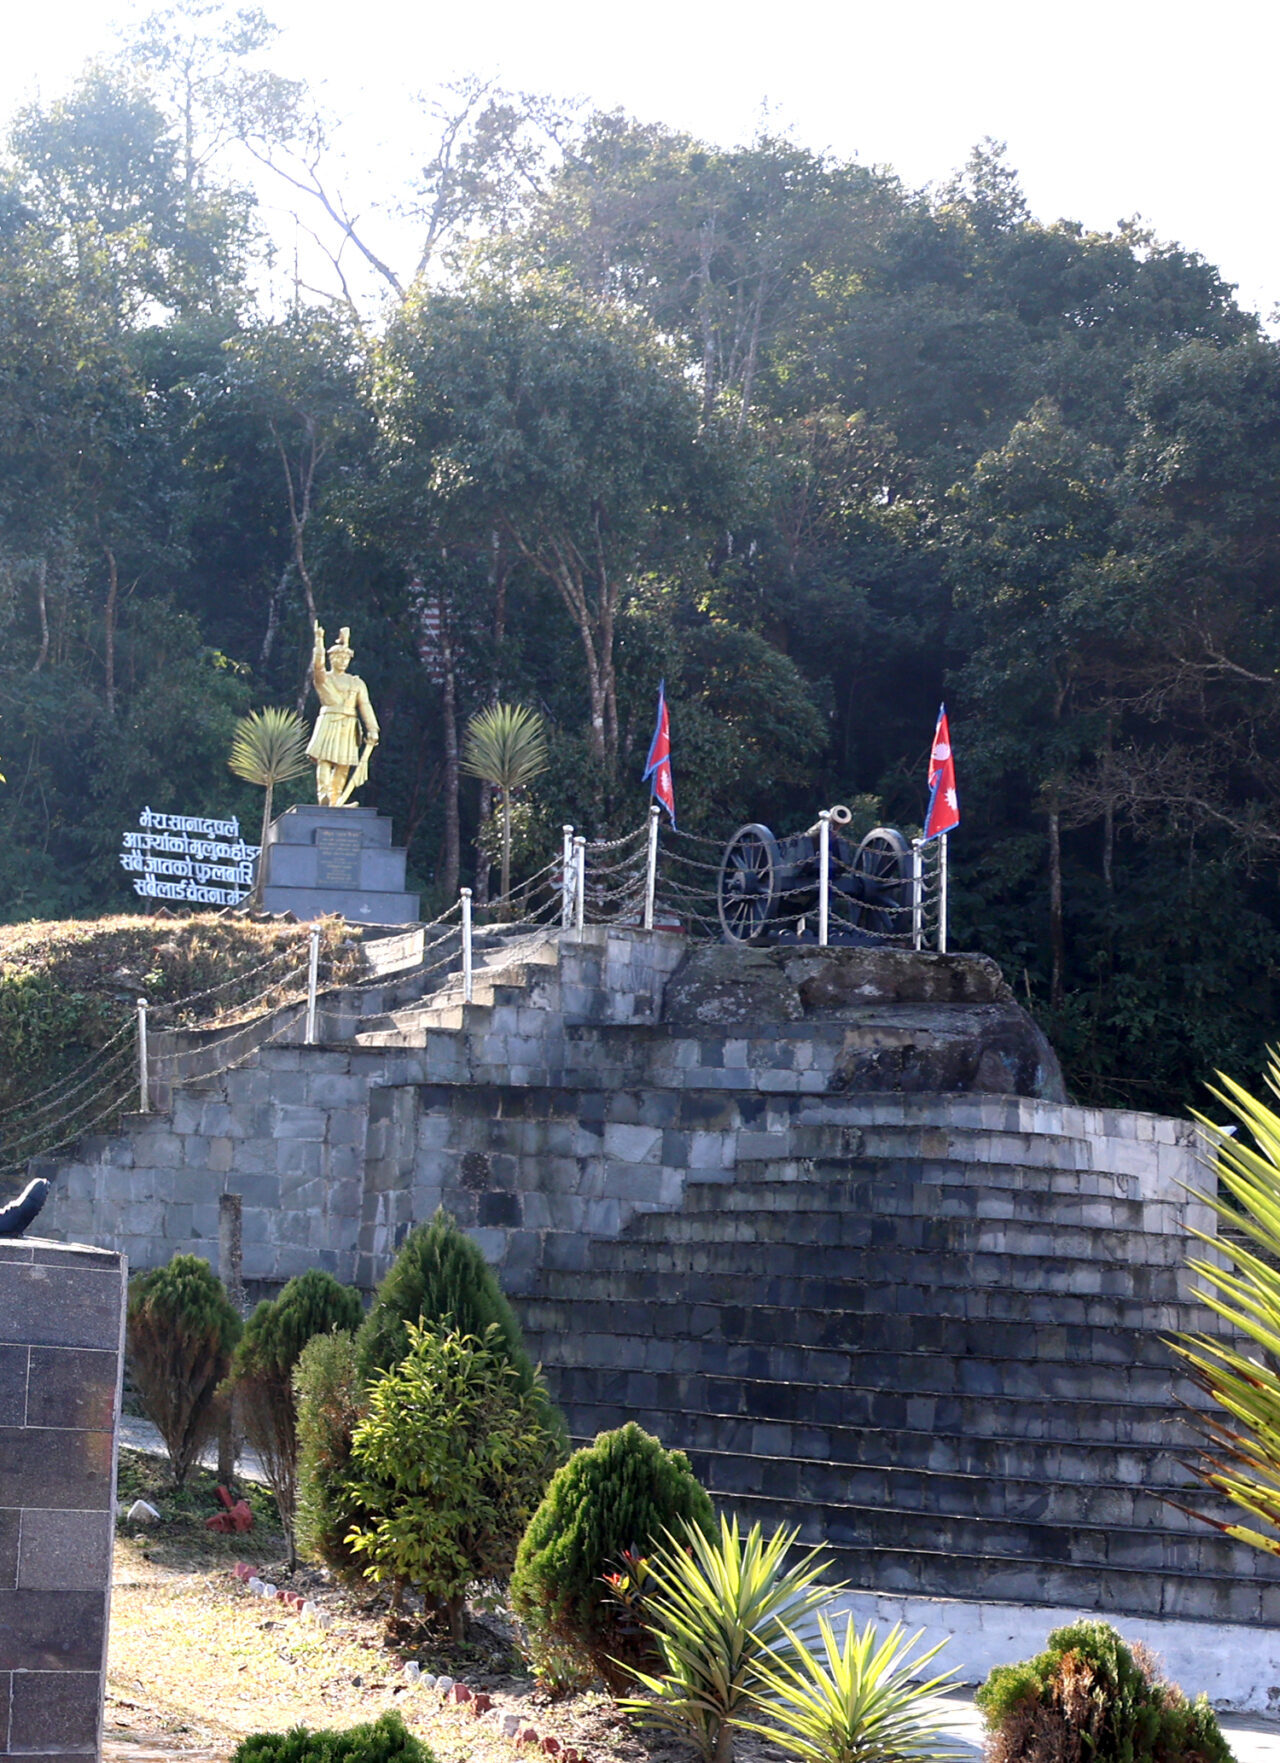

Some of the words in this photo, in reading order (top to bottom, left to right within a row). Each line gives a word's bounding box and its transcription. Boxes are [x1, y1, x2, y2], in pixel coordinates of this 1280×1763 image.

[139, 806, 167, 829] मेरा
[168, 814, 203, 832] साना
[189, 838, 231, 861] मुलुक
[143, 855, 193, 878] जातको
[186, 879, 226, 904] चेतना
